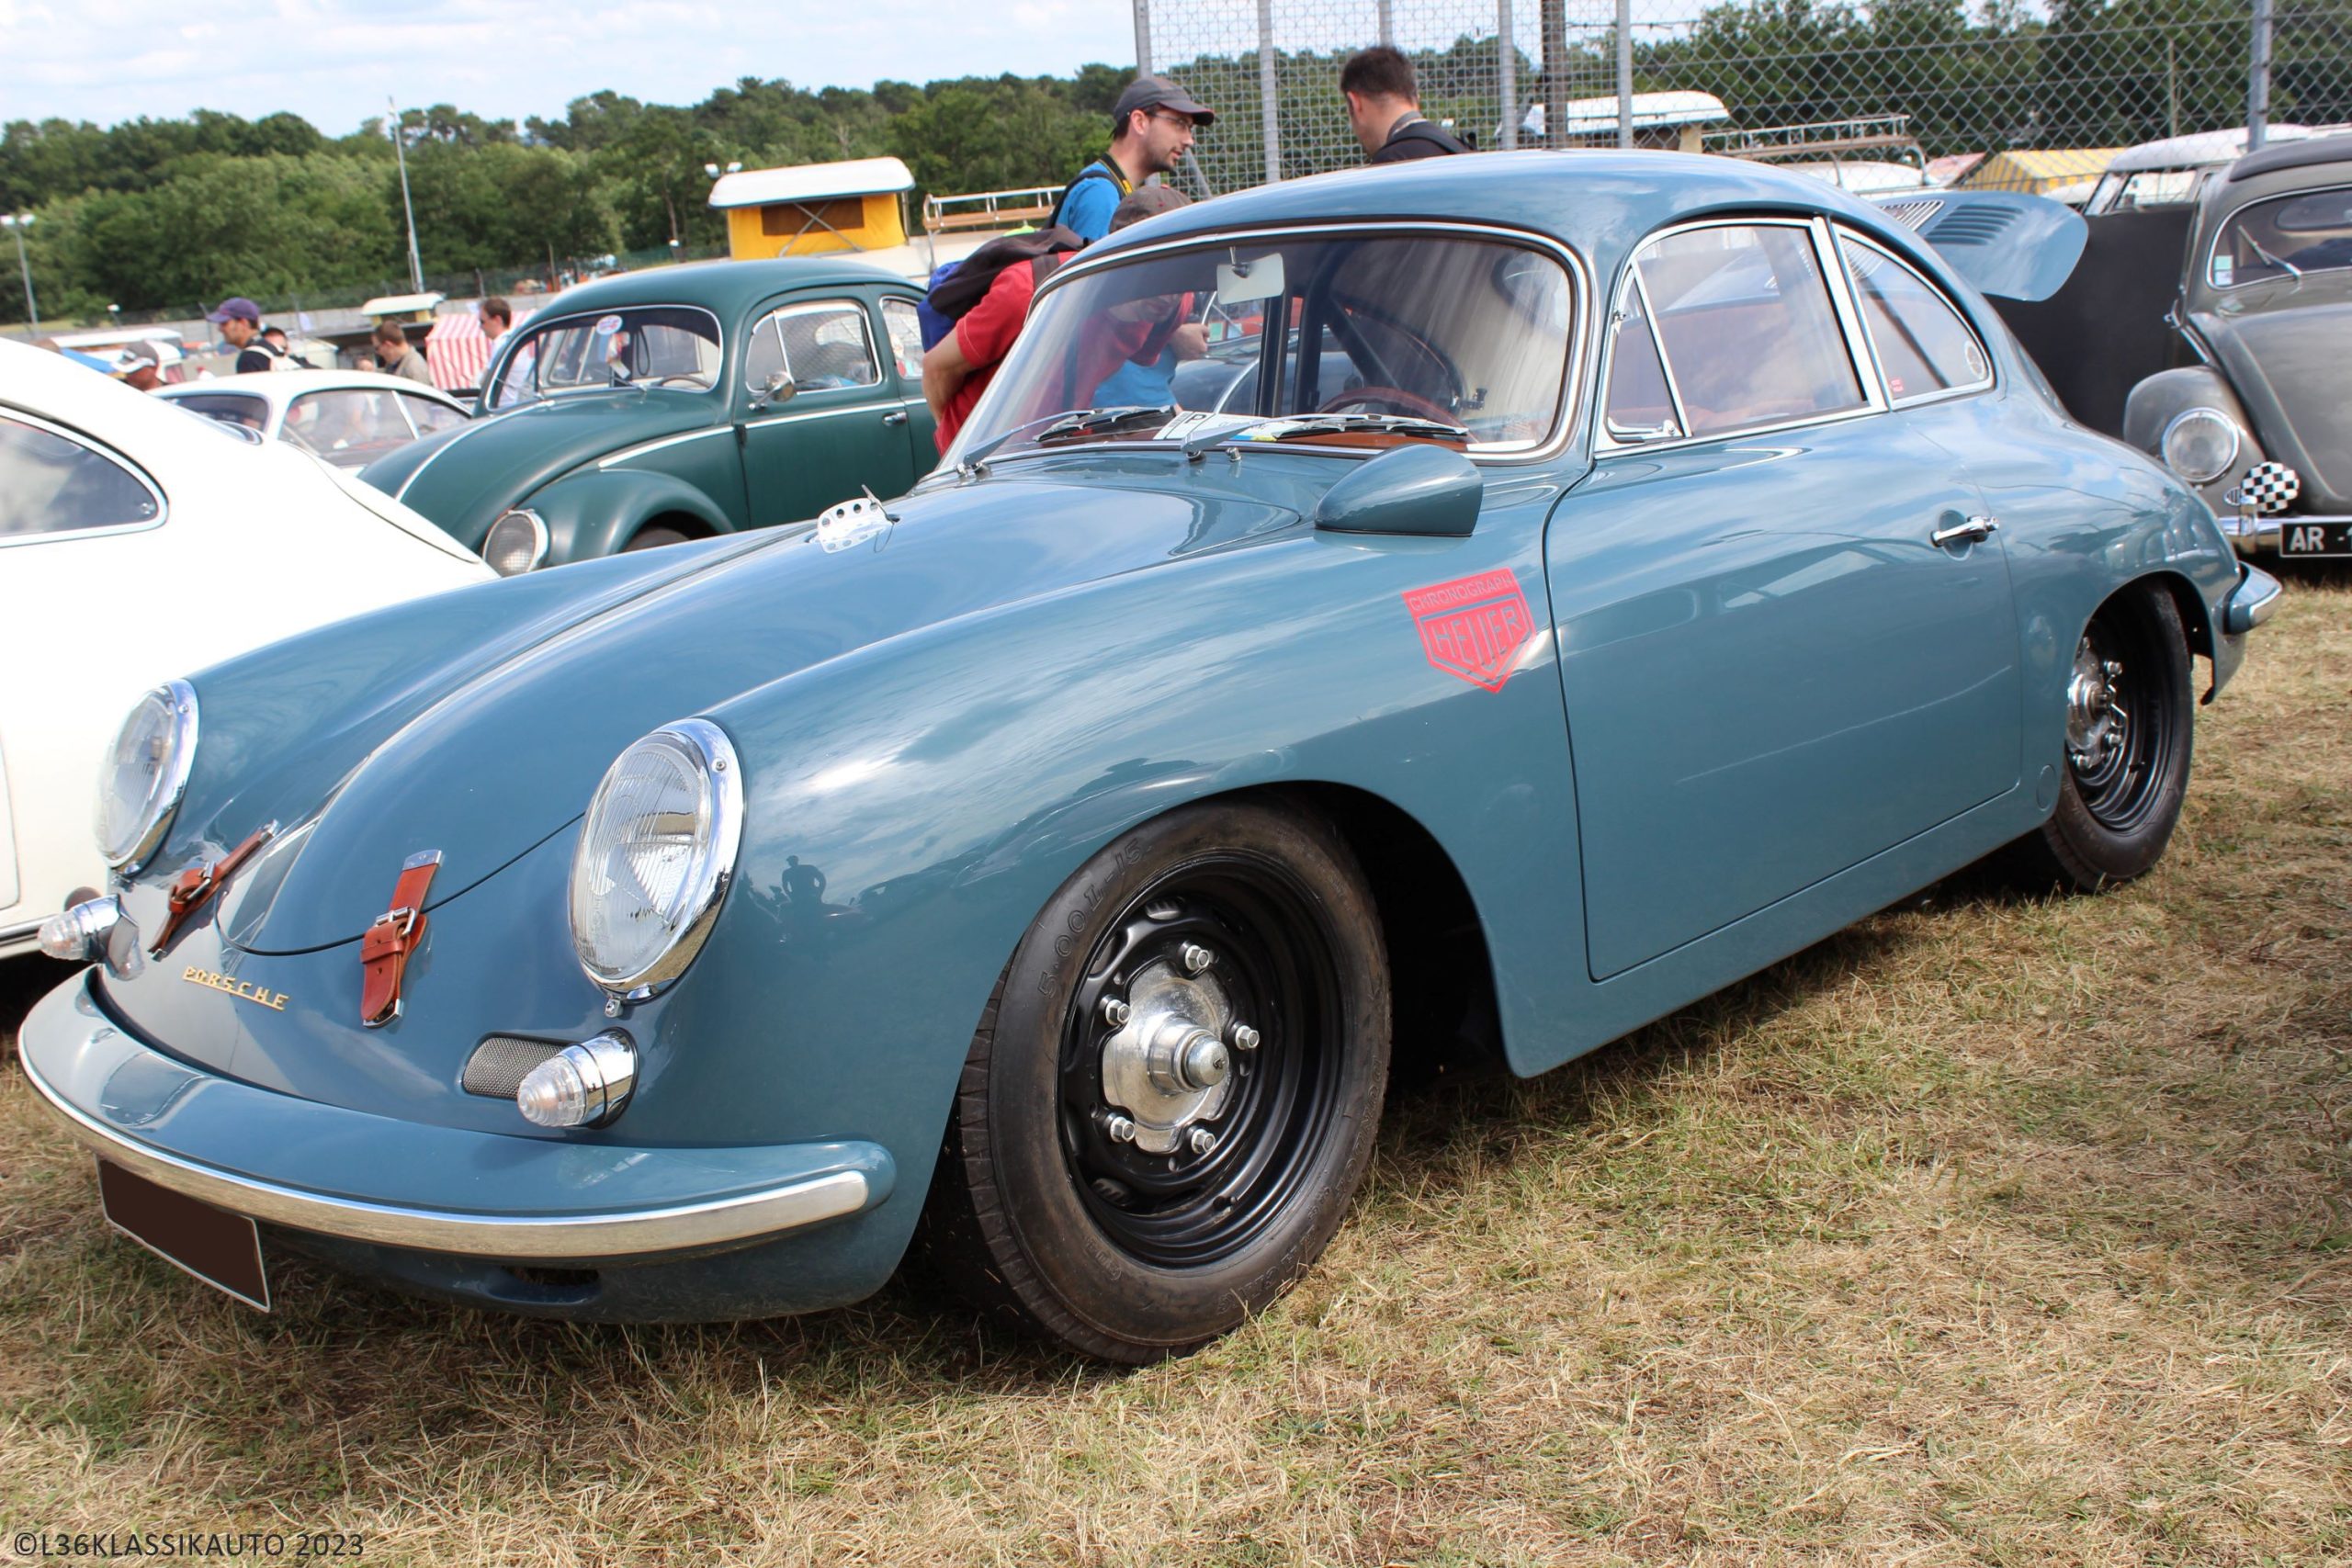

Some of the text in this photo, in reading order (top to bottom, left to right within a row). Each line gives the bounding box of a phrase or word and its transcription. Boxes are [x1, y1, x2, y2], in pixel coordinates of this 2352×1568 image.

[1408, 571, 1514, 612] CHRONOGRAPH
[1430, 606, 1521, 672] HEUER
[182, 965, 289, 1011] PORSCHE
